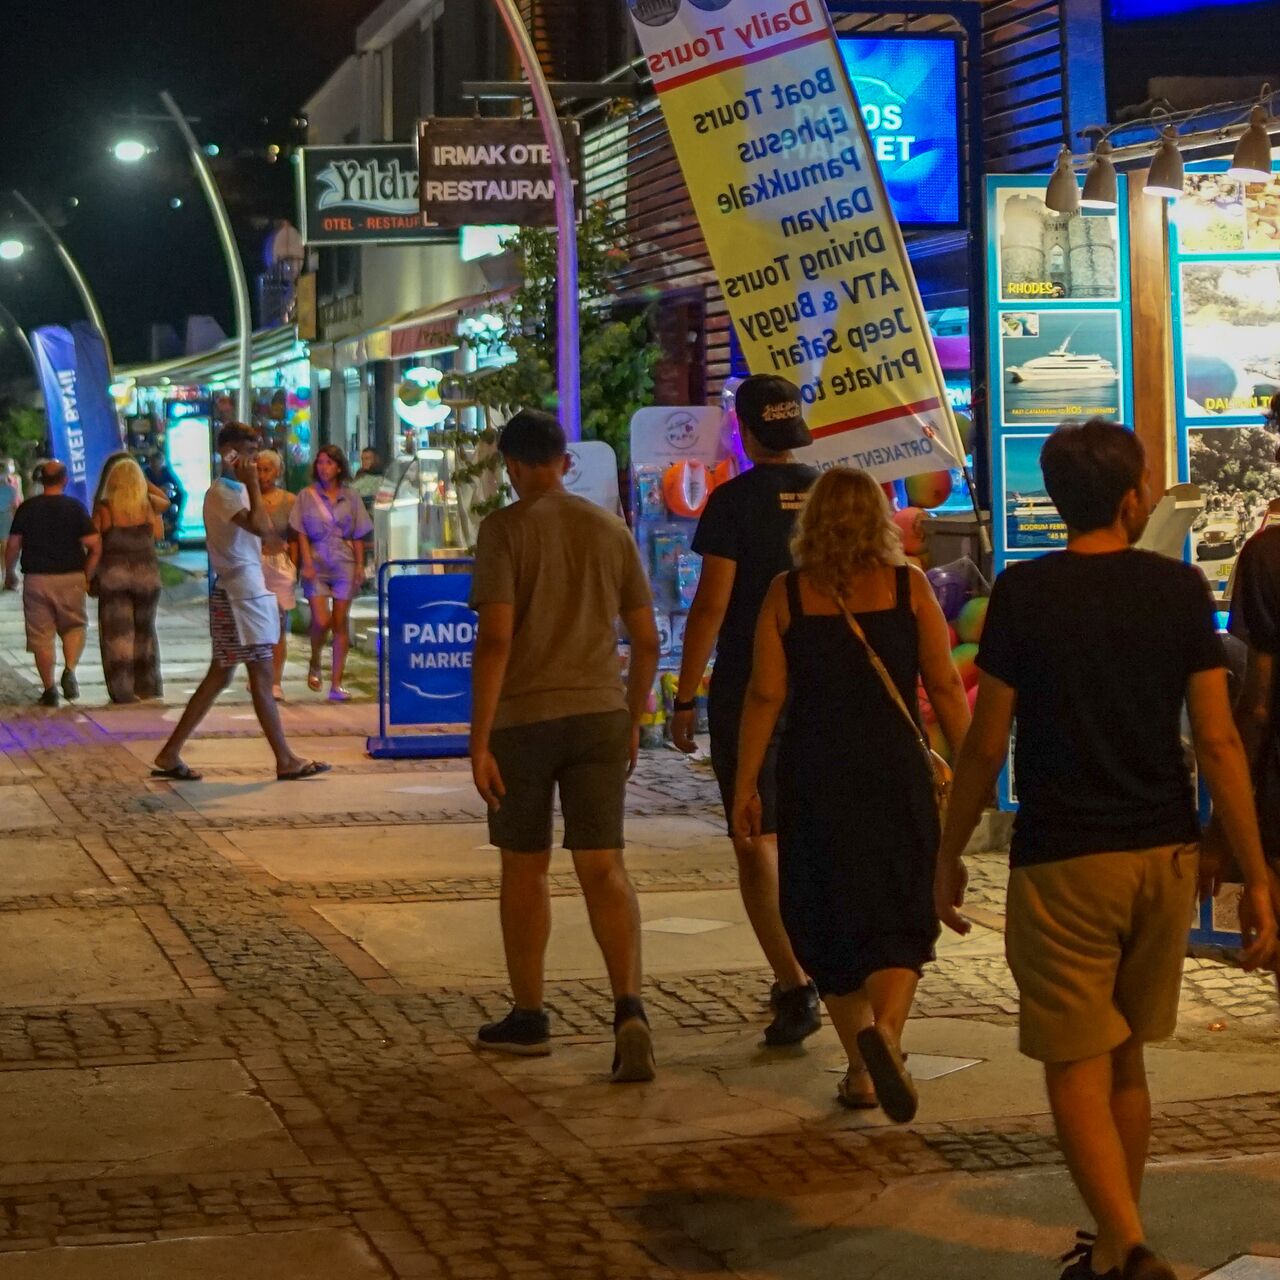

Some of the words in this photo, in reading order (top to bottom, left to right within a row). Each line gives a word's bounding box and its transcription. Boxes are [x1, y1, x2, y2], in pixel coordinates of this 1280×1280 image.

[434, 144, 507, 166] IRMAK
[510, 143, 569, 165] OTE
[324, 217, 354, 231] OTEL
[1007, 281, 1055, 295] RHODES
[1066, 405, 1083, 415] KOS
[1205, 396, 1263, 411] DALN
[410, 652, 473, 669] MARKE
